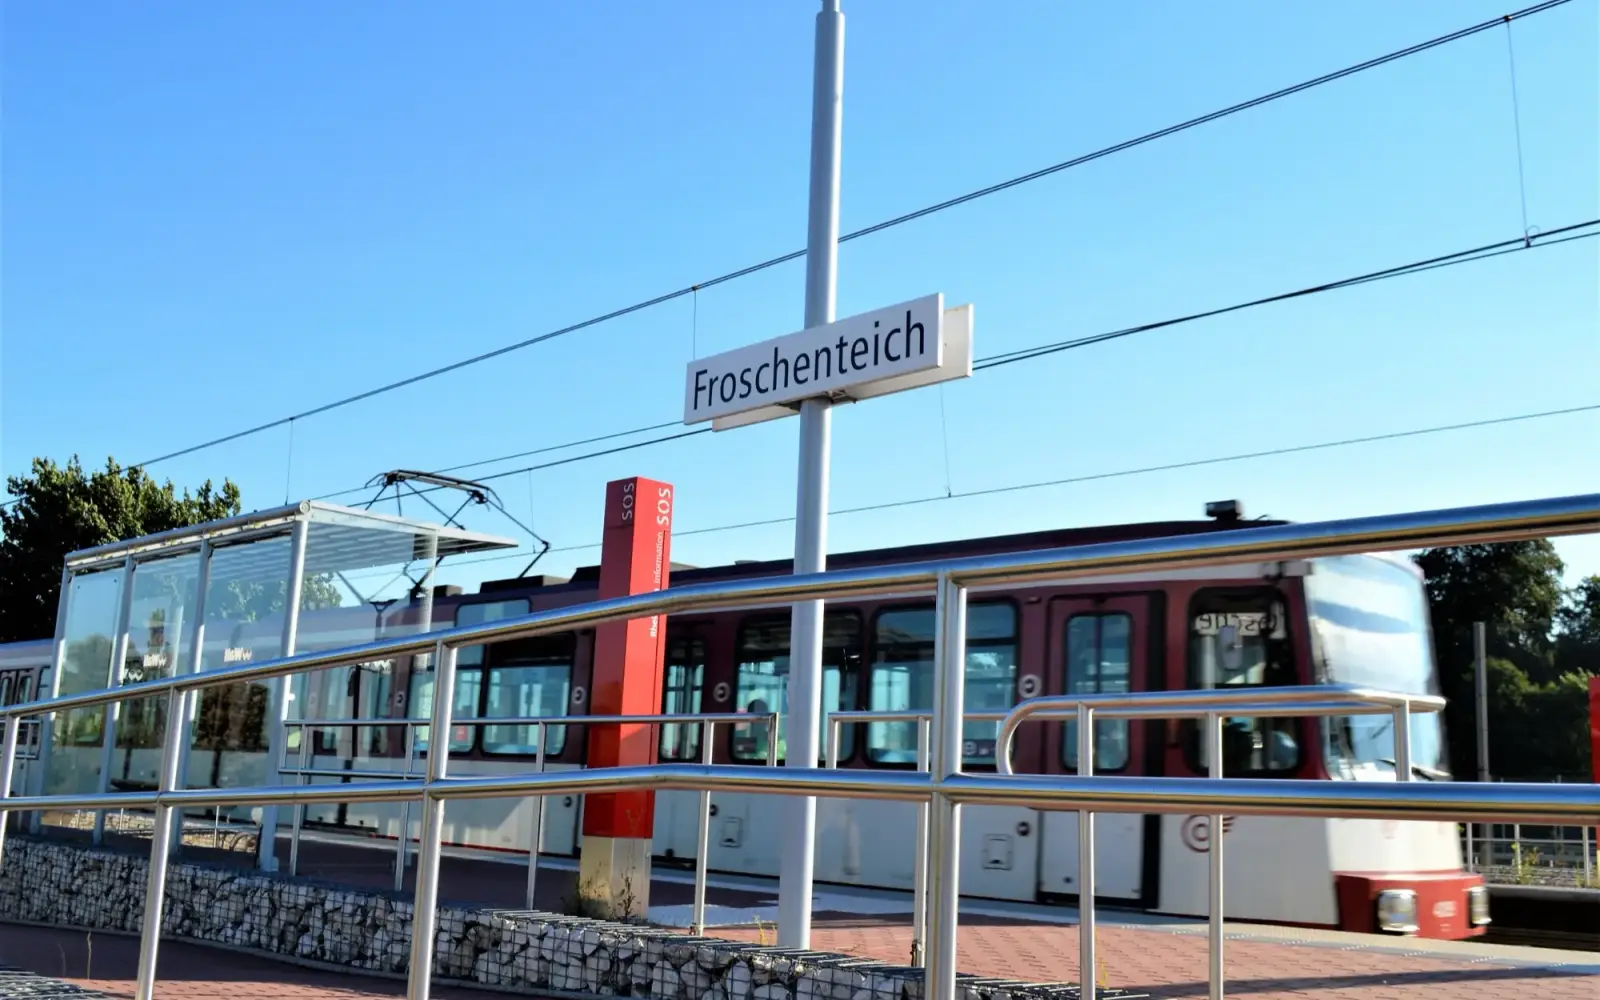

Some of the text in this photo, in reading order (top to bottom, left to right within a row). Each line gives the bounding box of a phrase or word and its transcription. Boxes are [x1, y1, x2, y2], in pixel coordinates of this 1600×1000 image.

[693, 310, 925, 411] Froschenteich
[621, 482, 635, 521] SOS
[656, 487, 671, 527] SOS
